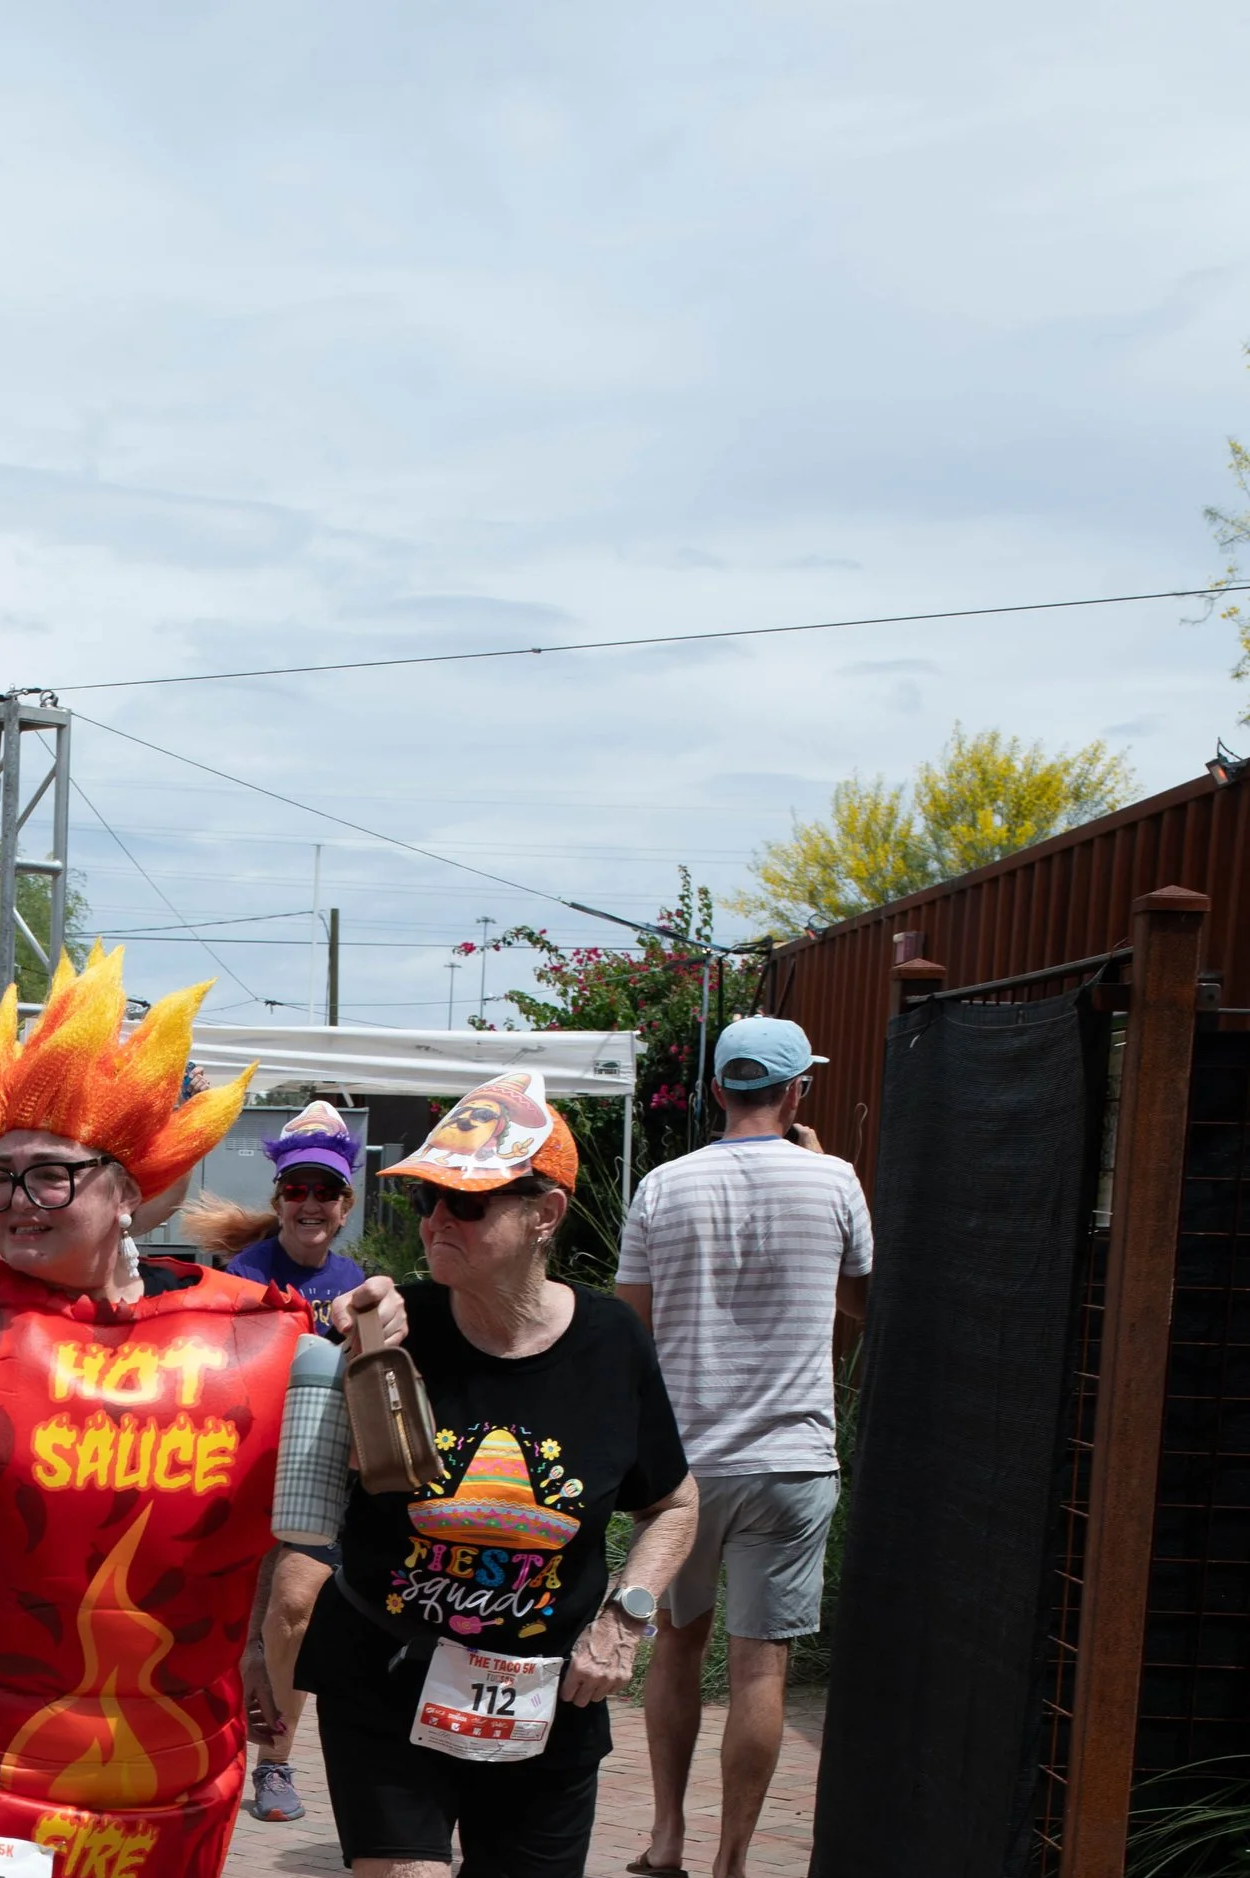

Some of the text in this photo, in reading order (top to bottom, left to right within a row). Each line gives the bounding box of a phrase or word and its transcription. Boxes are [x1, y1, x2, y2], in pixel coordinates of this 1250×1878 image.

[53, 1337, 225, 1406] HOT
[33, 1413, 237, 1494] SAUCE
[404, 1536, 563, 1589] FIESTA
[469, 1654, 536, 1674] THE TACO 5K
[471, 1682, 516, 1716] 112
